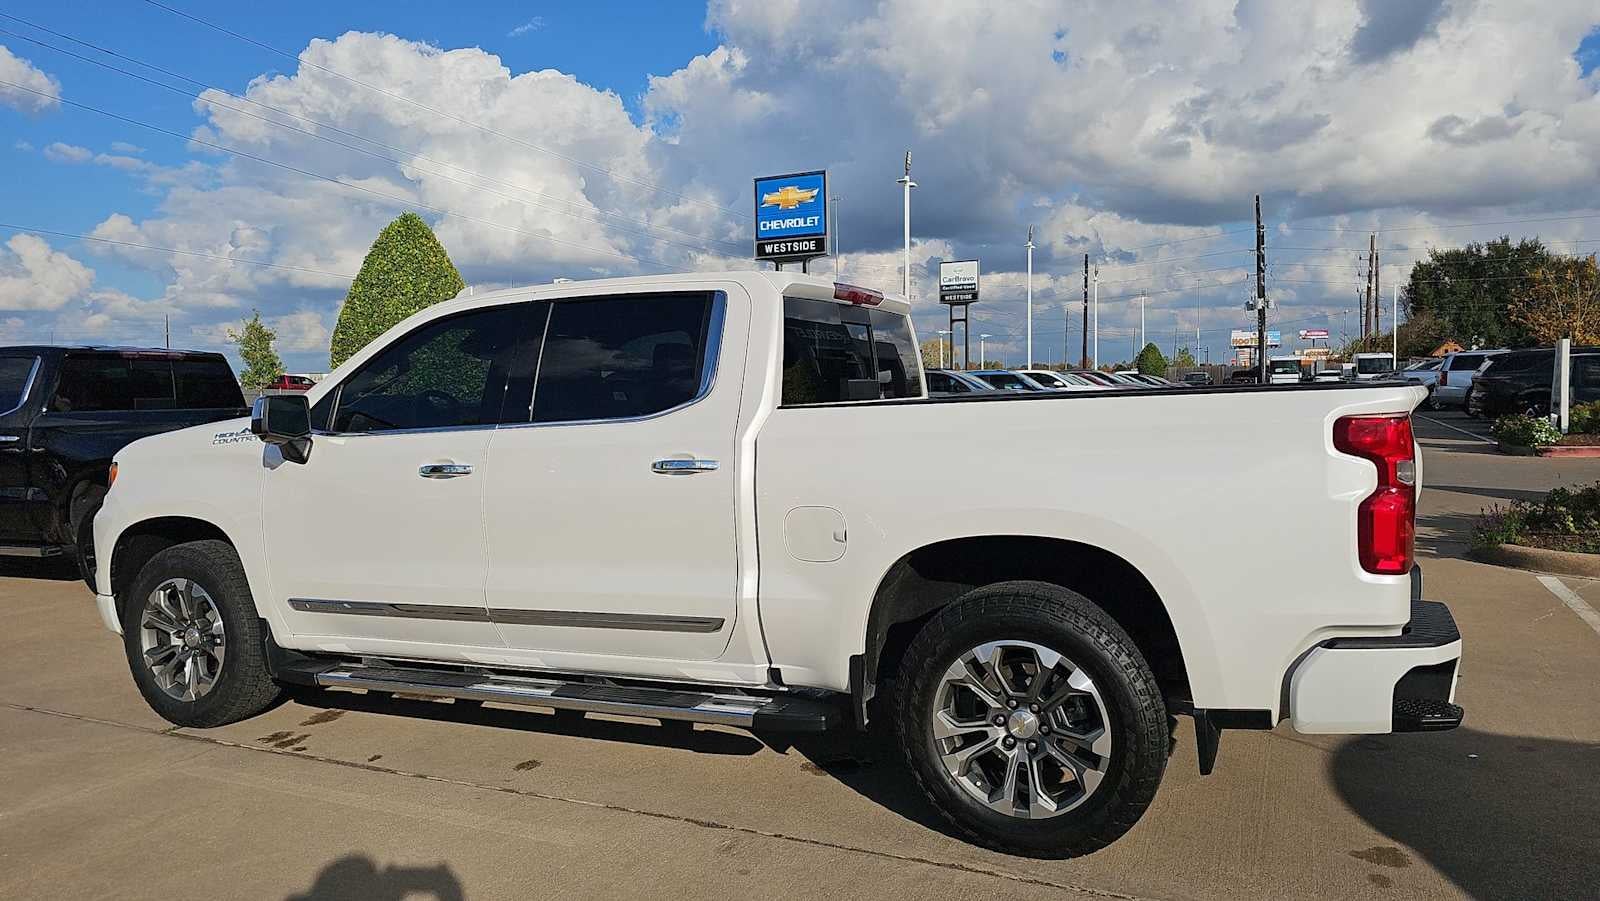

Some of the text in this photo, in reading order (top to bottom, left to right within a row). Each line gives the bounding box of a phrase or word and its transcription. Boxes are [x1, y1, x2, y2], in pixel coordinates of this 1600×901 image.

[760, 216, 820, 232] CHEVROLET
[764, 241, 816, 253] WESTSIDE
[212, 436, 258, 445] COUNTRY
